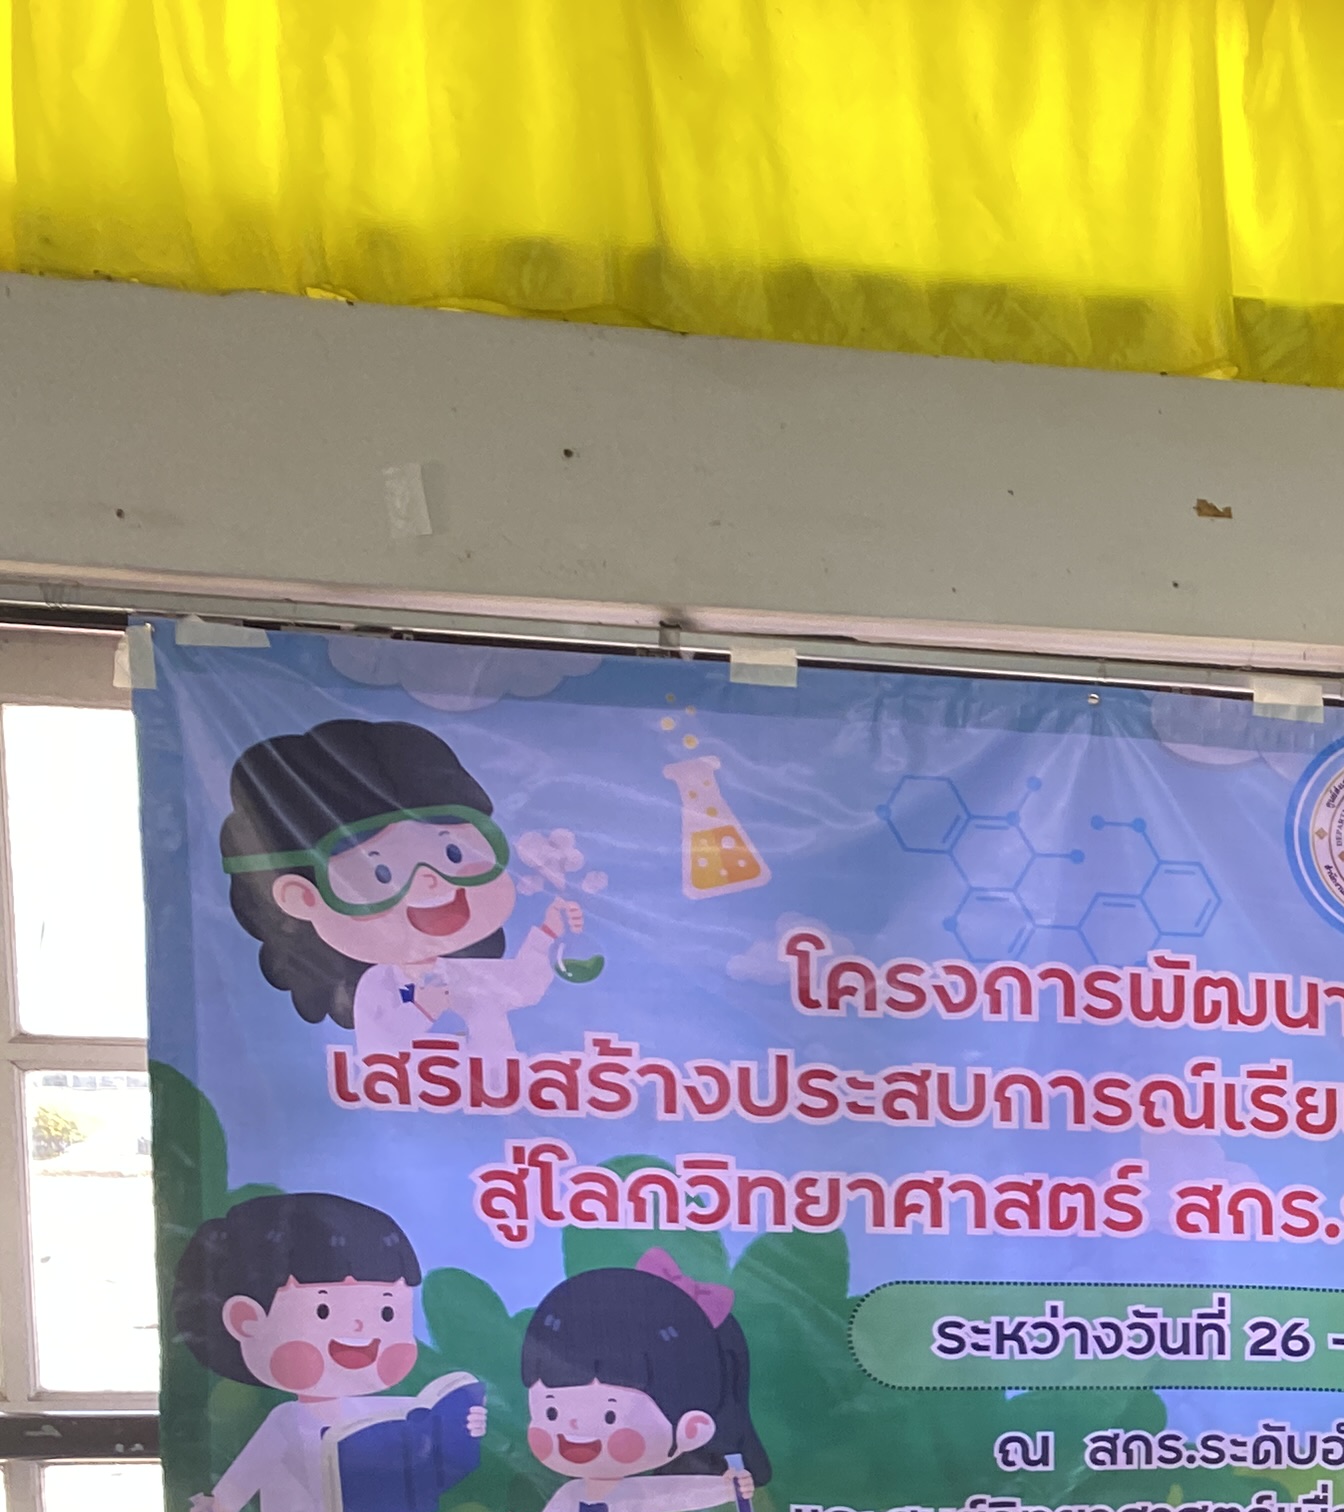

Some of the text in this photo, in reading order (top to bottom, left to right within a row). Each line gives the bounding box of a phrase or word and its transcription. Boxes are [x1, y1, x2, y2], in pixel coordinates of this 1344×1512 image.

[478, 1140, 1143, 1242] สู่โลกวิทยาศาสตร์
[934, 1298, 1229, 1360] ระหว่างวันที่
[1247, 1319, 1311, 1359] 26
[998, 1433, 1051, 1469] ณ
